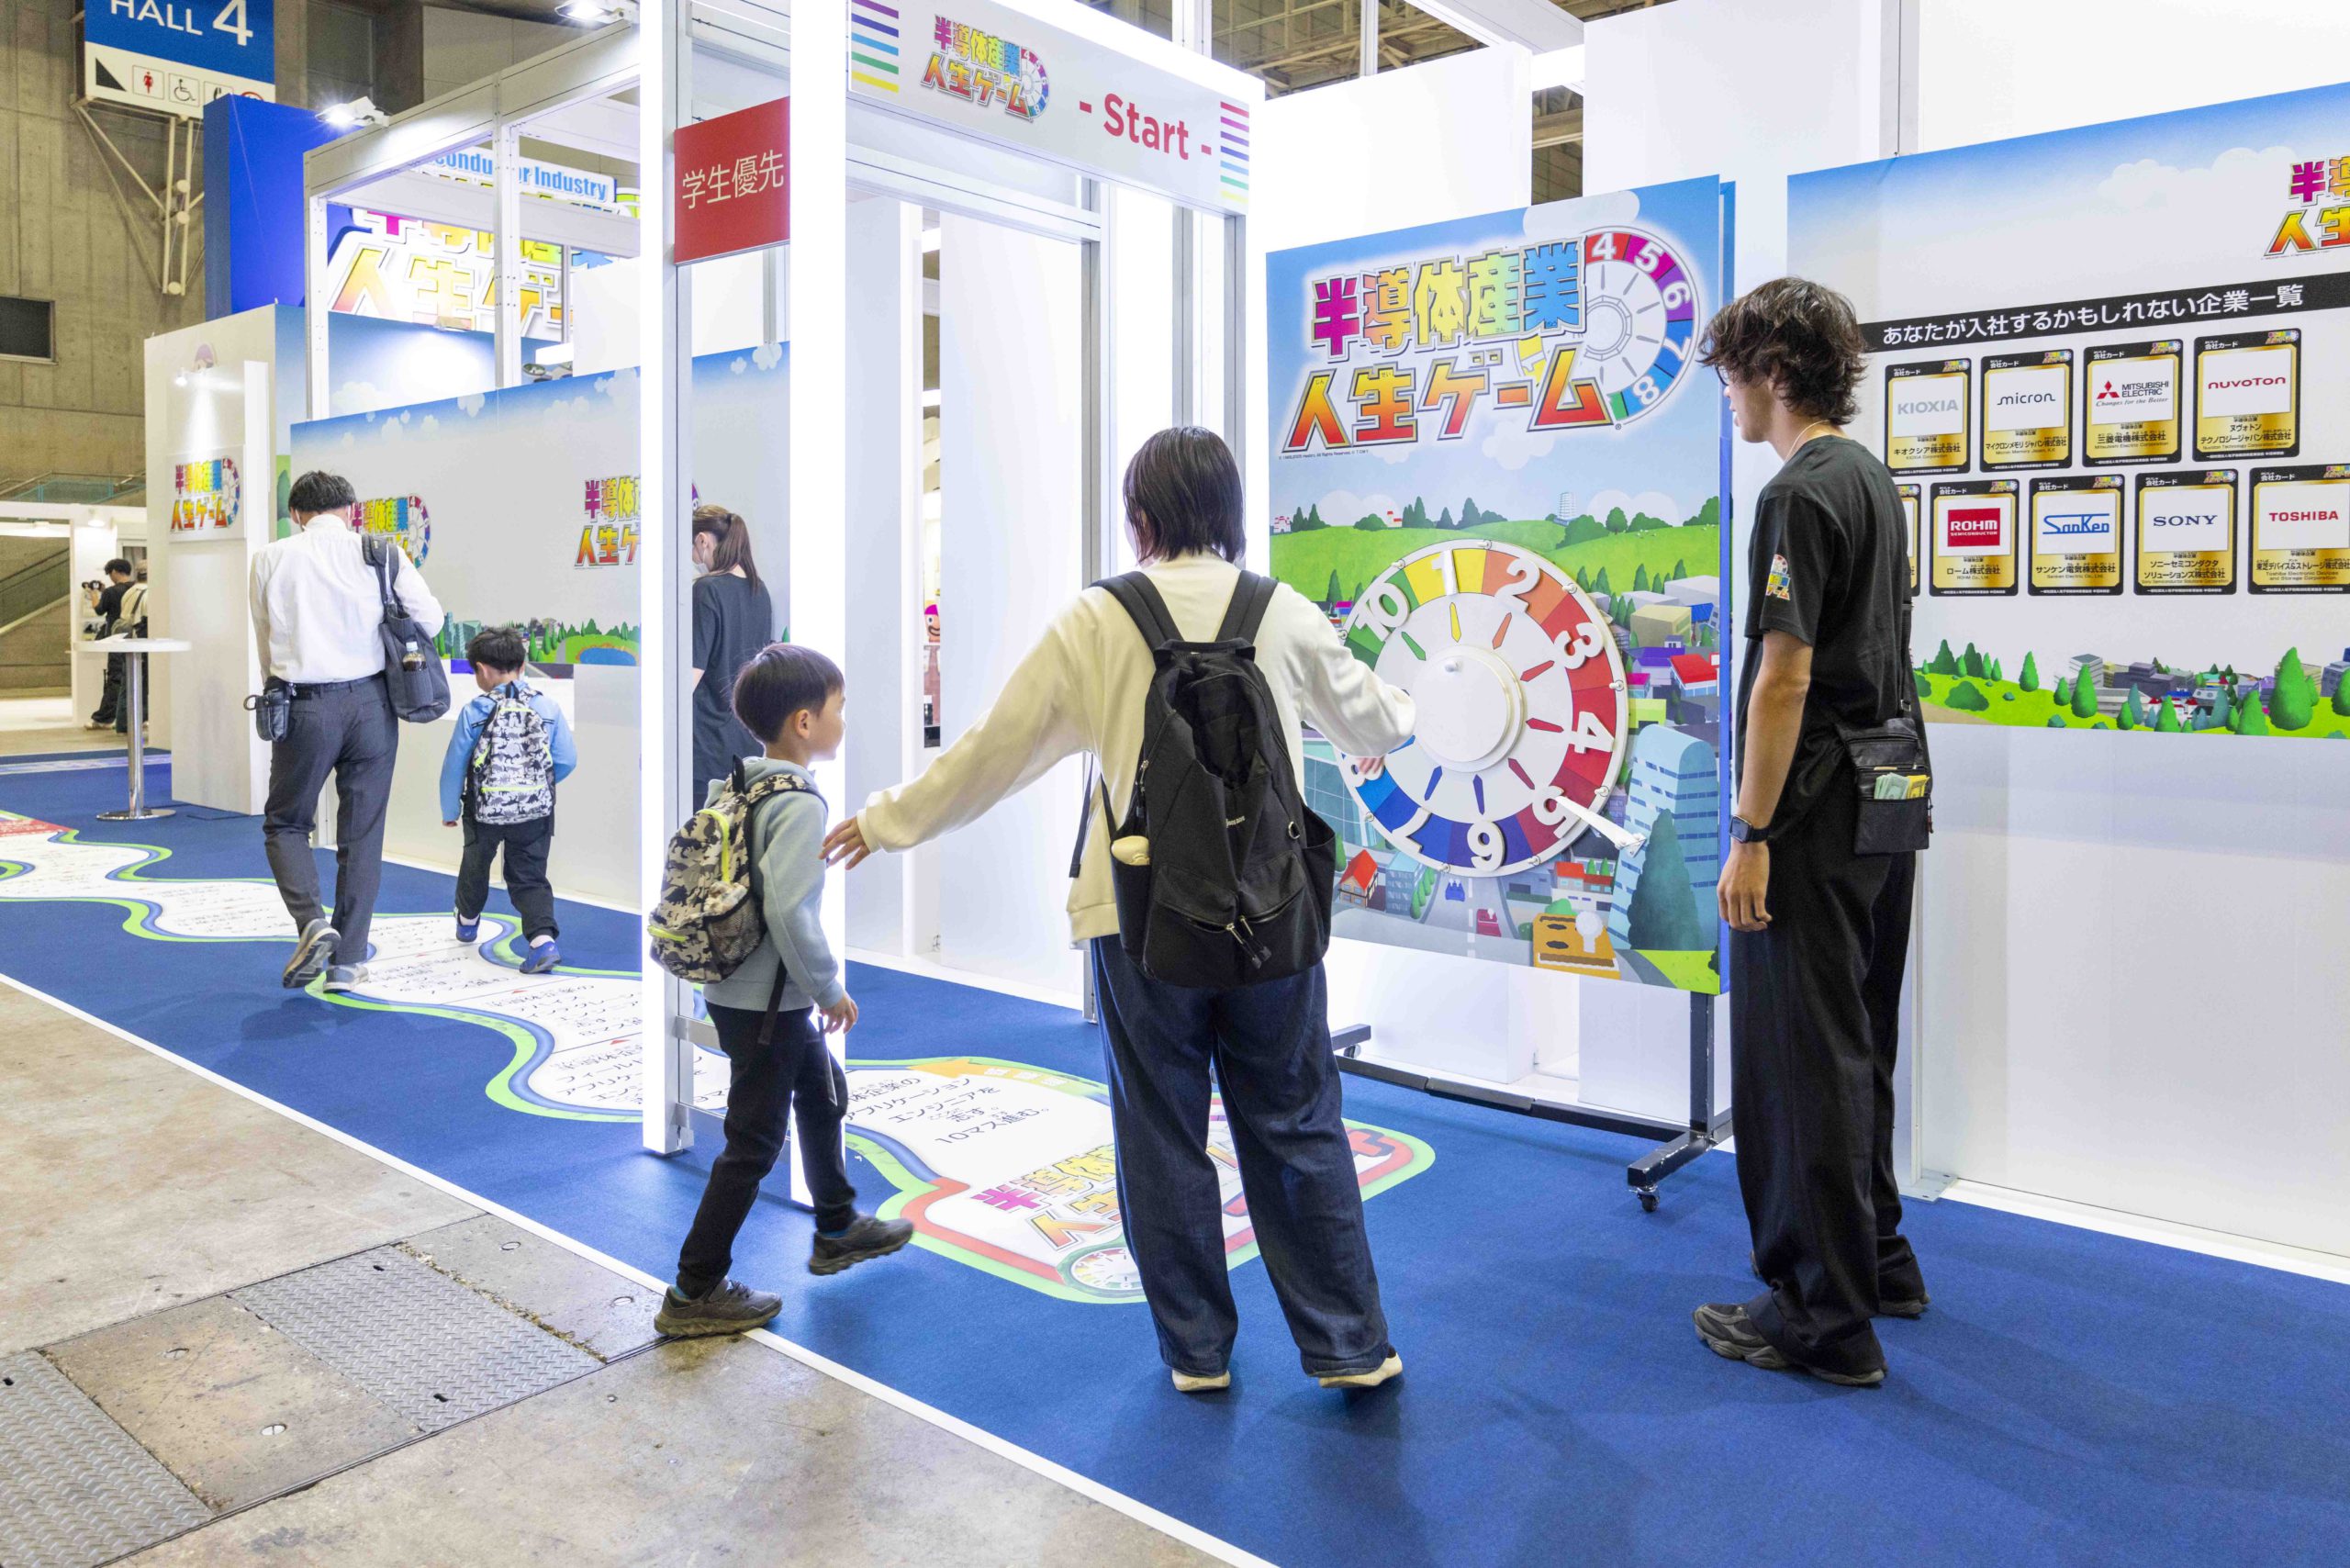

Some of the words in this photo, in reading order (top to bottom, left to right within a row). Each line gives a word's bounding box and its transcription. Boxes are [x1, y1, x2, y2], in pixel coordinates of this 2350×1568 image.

[111, 0, 203, 36] HALL
[212, 0, 253, 46] 4
[934, 15, 1021, 79] 半導体産業
[921, 53, 1031, 118] 人生ゲーム
[1103, 93, 1189, 161] Start
[534, 166, 607, 201] Industry
[682, 150, 784, 209] 学生優先
[1592, 233, 1617, 260] 4
[1634, 241, 1664, 274] 5
[1315, 241, 1579, 356] 半導体産業
[1662, 282, 1691, 309] 6
[1883, 285, 2304, 345] あなたが入社するかもしれない企業一覧
[1288, 348, 1608, 447] 人生ゲーム
[1633, 375, 1660, 405] 8
[1998, 392, 2055, 405] micron
[2122, 381, 2169, 390] MITSUBISHI
[2122, 389, 2163, 398] ELECTRIC
[1897, 399, 1958, 414] KIOXIA
[1895, 445, 1961, 454] キオクシア株式会社
[2098, 433, 2166, 444] 三菱電機株式会社
[2201, 432, 2291, 444] テクノロジージャパン株式会社
[171, 497, 228, 531] 人生ゲーム
[585, 476, 641, 519] 半導体
[1951, 521, 1998, 531] ROHM
[2042, 513, 2109, 534] SanKen
[2154, 515, 2218, 526] SONY
[2269, 511, 2339, 521] TOSHIBA
[1432, 550, 1460, 595] 1
[1494, 557, 1541, 612] 2
[2036, 566, 2116, 574] サンケン電気株式会社
[1354, 580, 1409, 635] 10
[1561, 622, 1605, 670] 3
[1562, 711, 1615, 754] 4
[1392, 807, 1432, 854] 7
[889, 1087, 1002, 1124] エンジニアを
